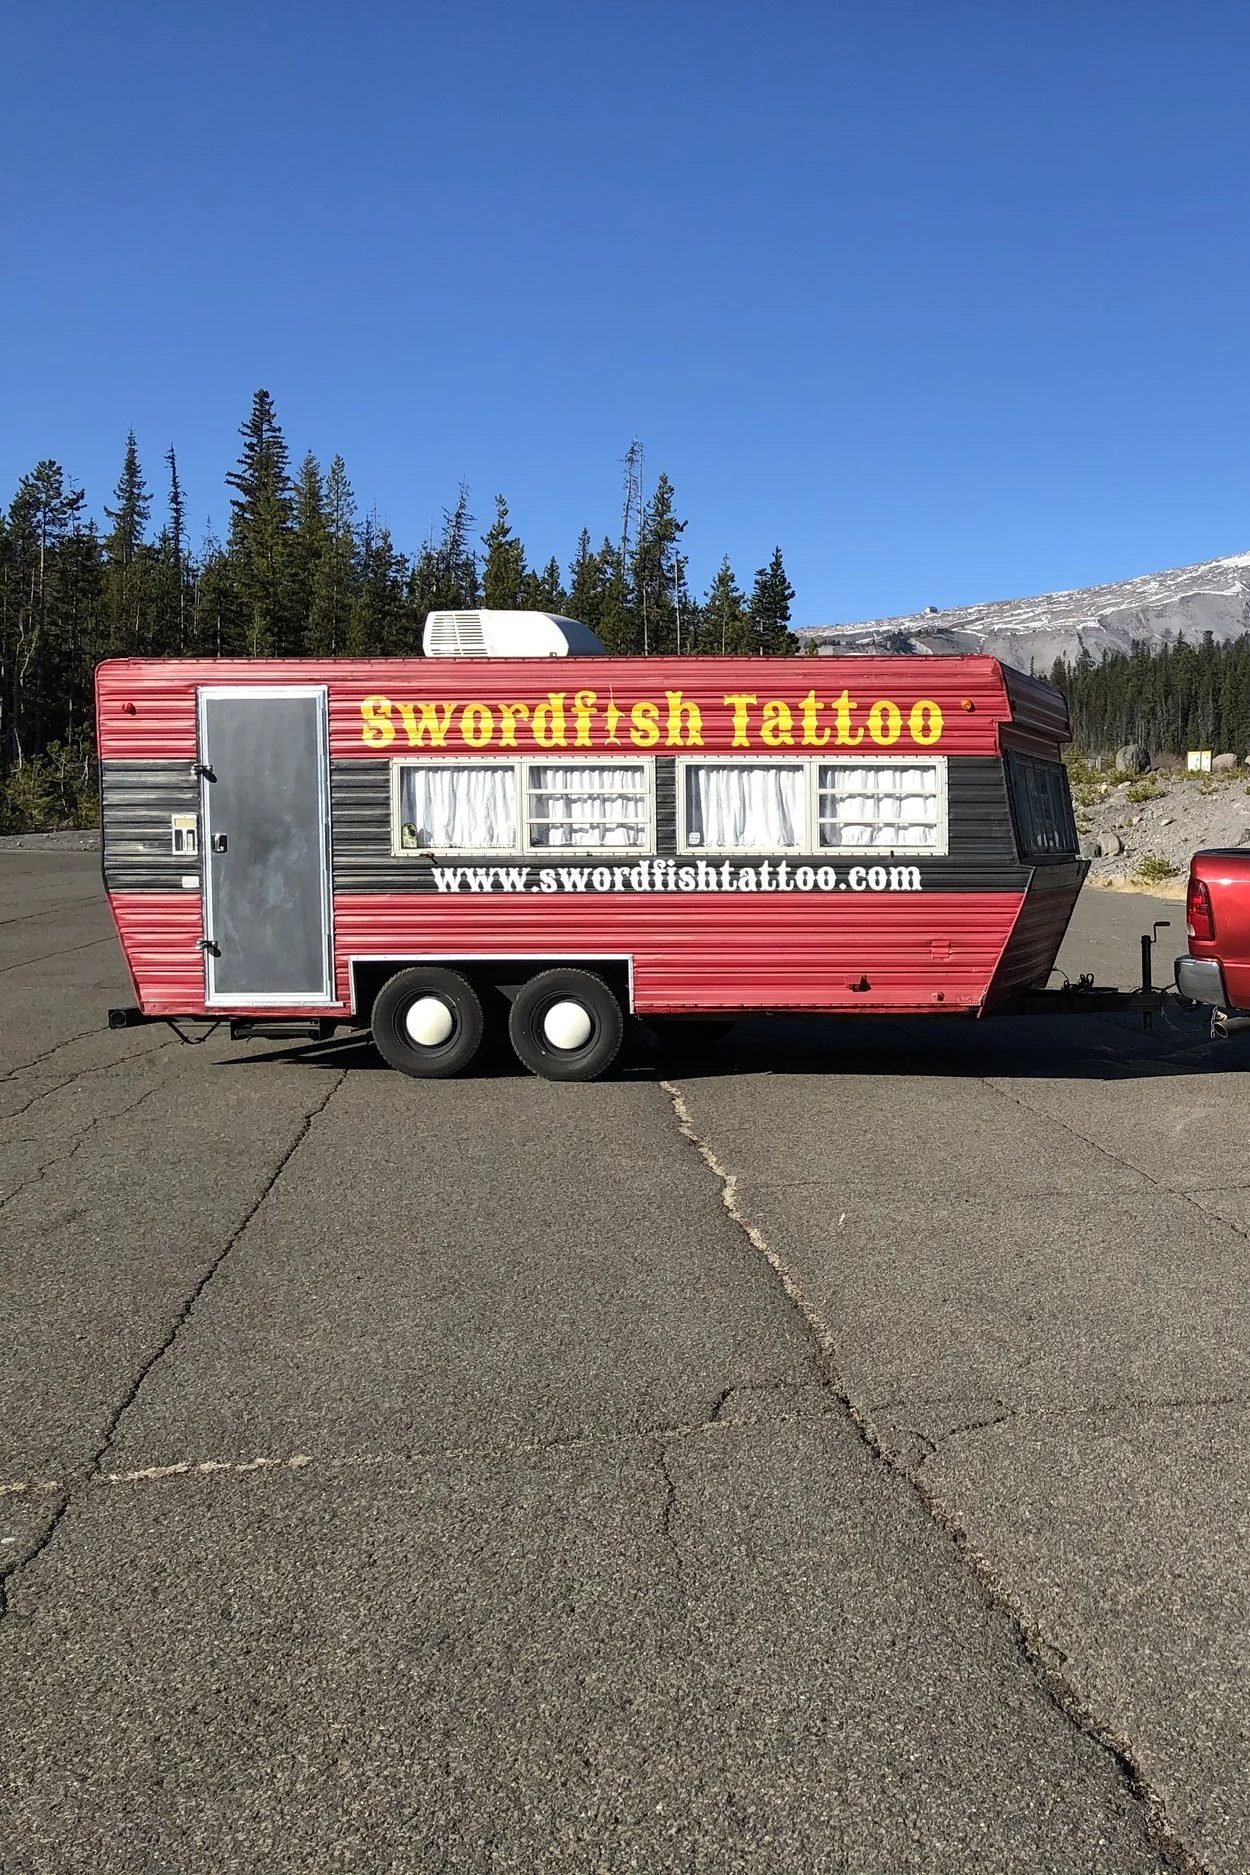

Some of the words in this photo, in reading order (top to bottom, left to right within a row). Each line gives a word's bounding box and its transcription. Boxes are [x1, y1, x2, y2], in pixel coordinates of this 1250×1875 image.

[360, 684, 704, 748] Swordfish
[723, 690, 944, 747] Tattoo
[431, 859, 922, 893] www.swordfishtattoo.com
